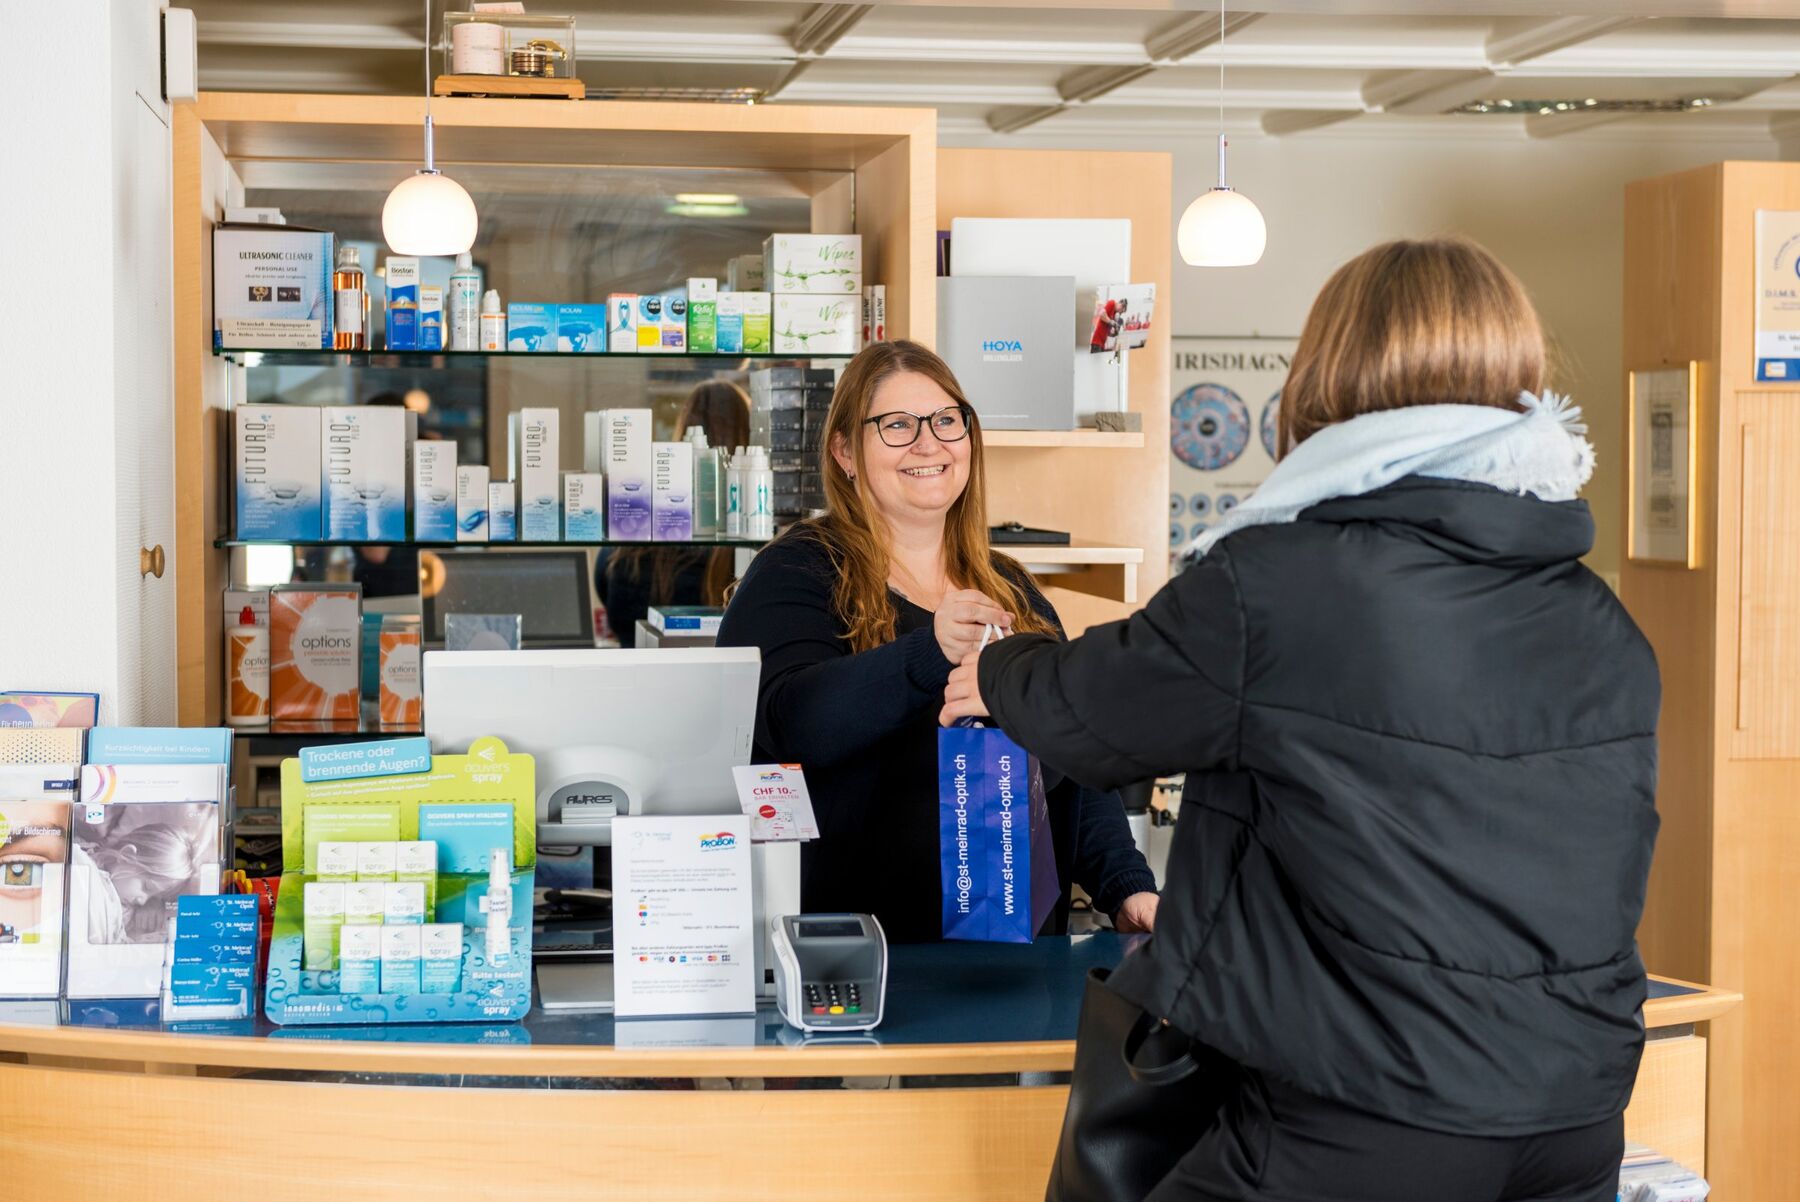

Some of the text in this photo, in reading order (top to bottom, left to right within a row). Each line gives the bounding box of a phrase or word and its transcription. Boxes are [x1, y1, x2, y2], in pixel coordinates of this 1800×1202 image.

[240, 252, 284, 260] ULTRASONIC
[983, 340, 1022, 352] HOYA
[526, 426, 541, 468] FUTURO
[613, 422, 627, 462] FUTURO
[245, 423, 266, 484] FUTURO
[330, 424, 351, 484] FUTURO
[657, 452, 670, 490] FUTURO
[302, 635, 351, 650] options
[244, 656, 269, 666] option
[388, 665, 416, 674] options
[307, 746, 396, 763] Trockene oder
[308, 756, 425, 776] brennende Augen?
[472, 774, 503, 784] spray
[753, 788, 774, 796] CHF
[954, 754, 972, 914] info@st-meinrad-optik.ch
[998, 755, 1014, 915] www.st-meinrad-optik.ch
[484, 1006, 510, 1015] spray
